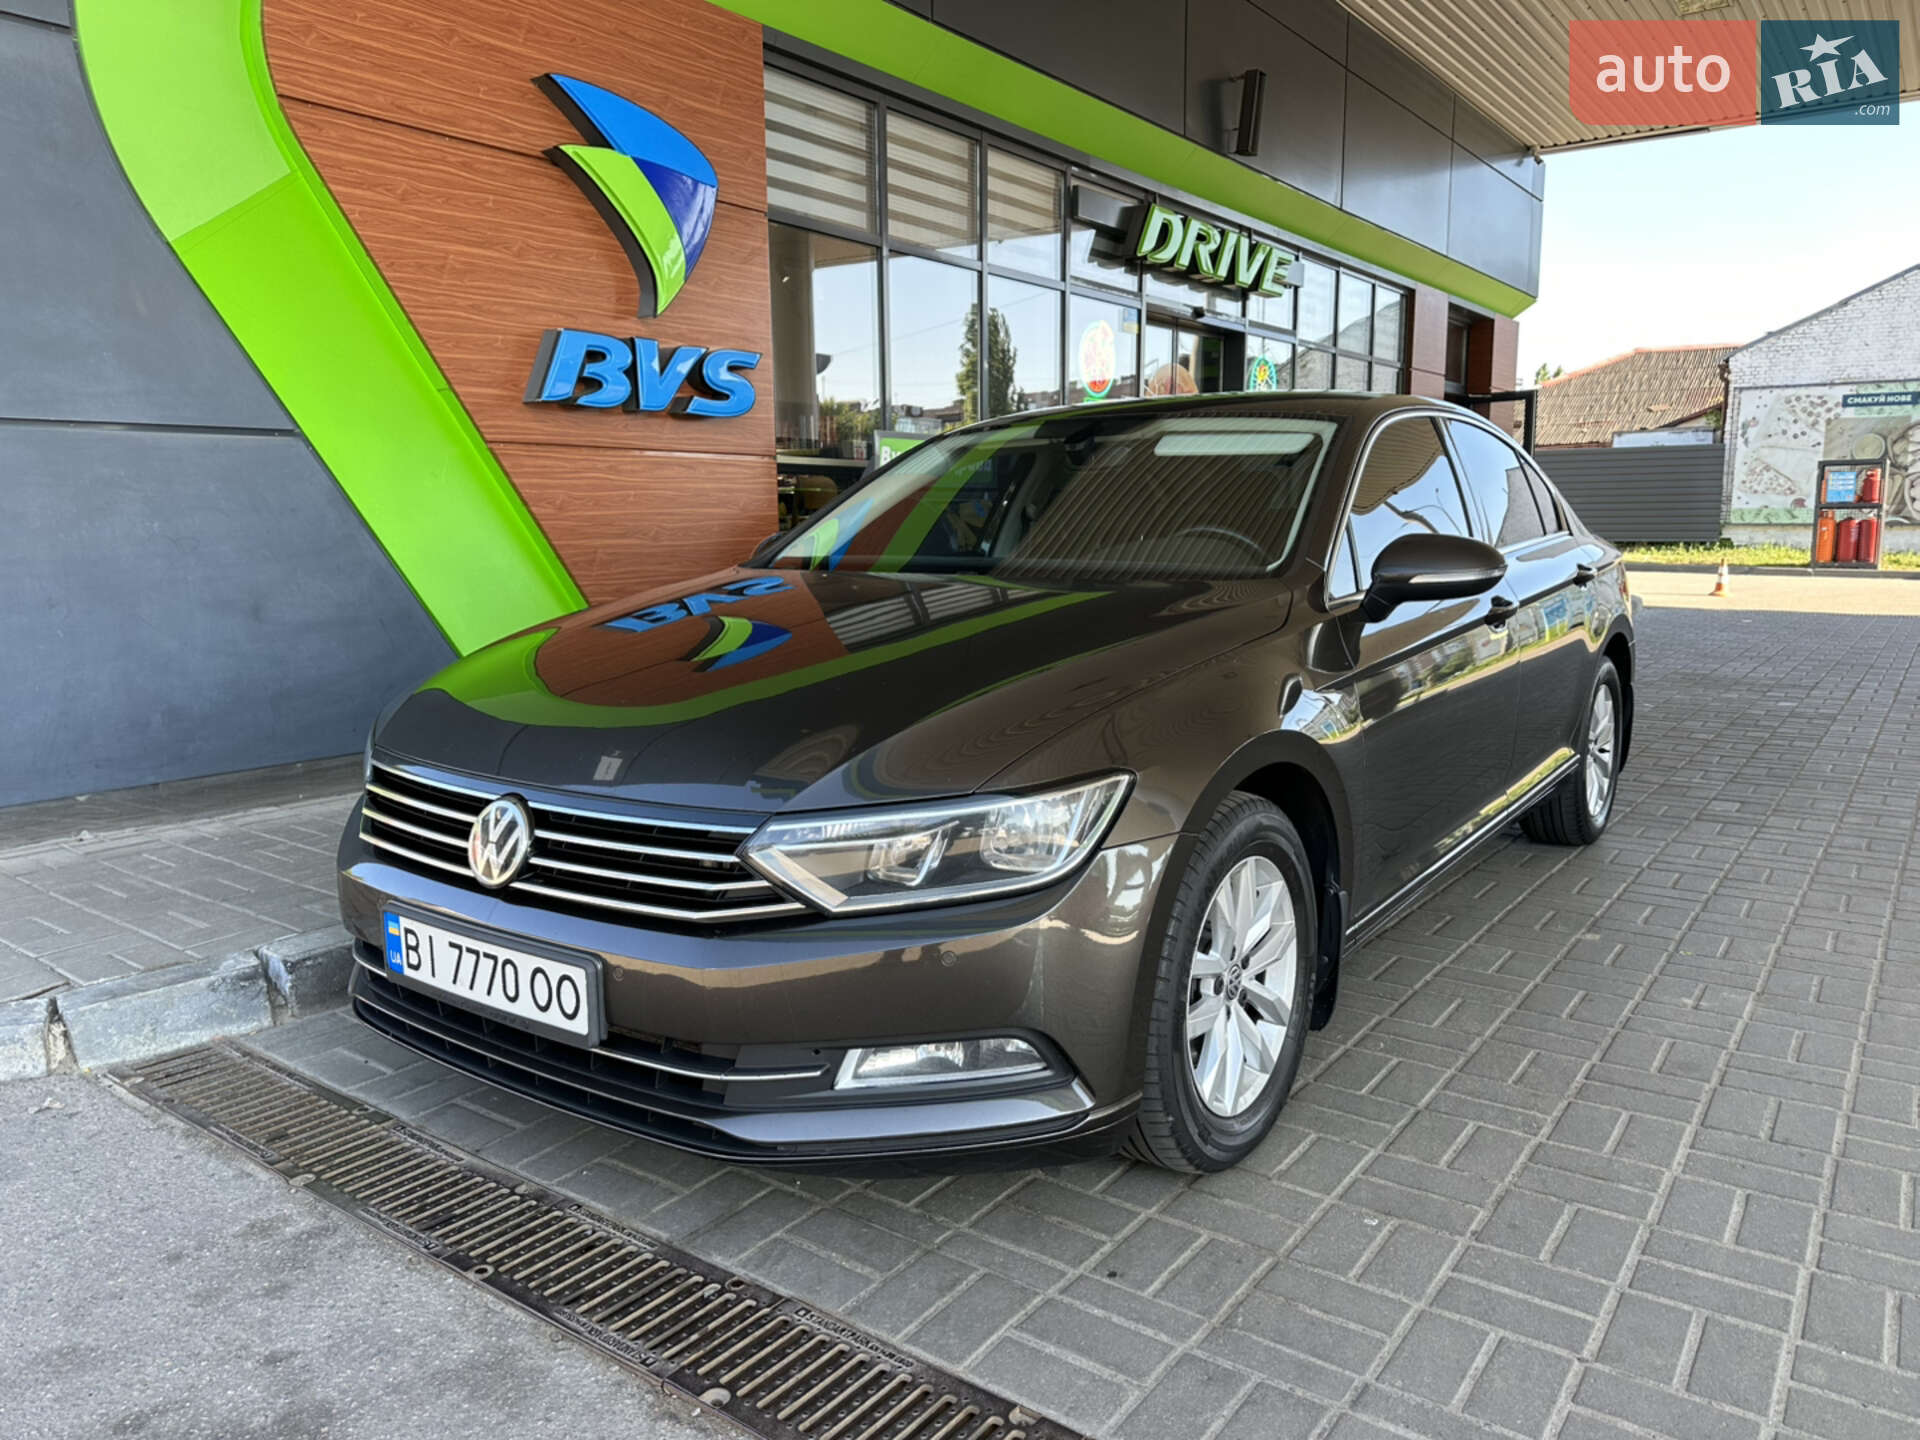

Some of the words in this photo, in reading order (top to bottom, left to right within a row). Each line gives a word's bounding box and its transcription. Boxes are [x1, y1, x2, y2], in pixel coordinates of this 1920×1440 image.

[1136, 203, 1296, 298] DRIVE
[524, 327, 763, 418] BVS
[390, 950, 402, 967] UA
[403, 926, 436, 978] BI
[448, 940, 520, 1003] 7770
